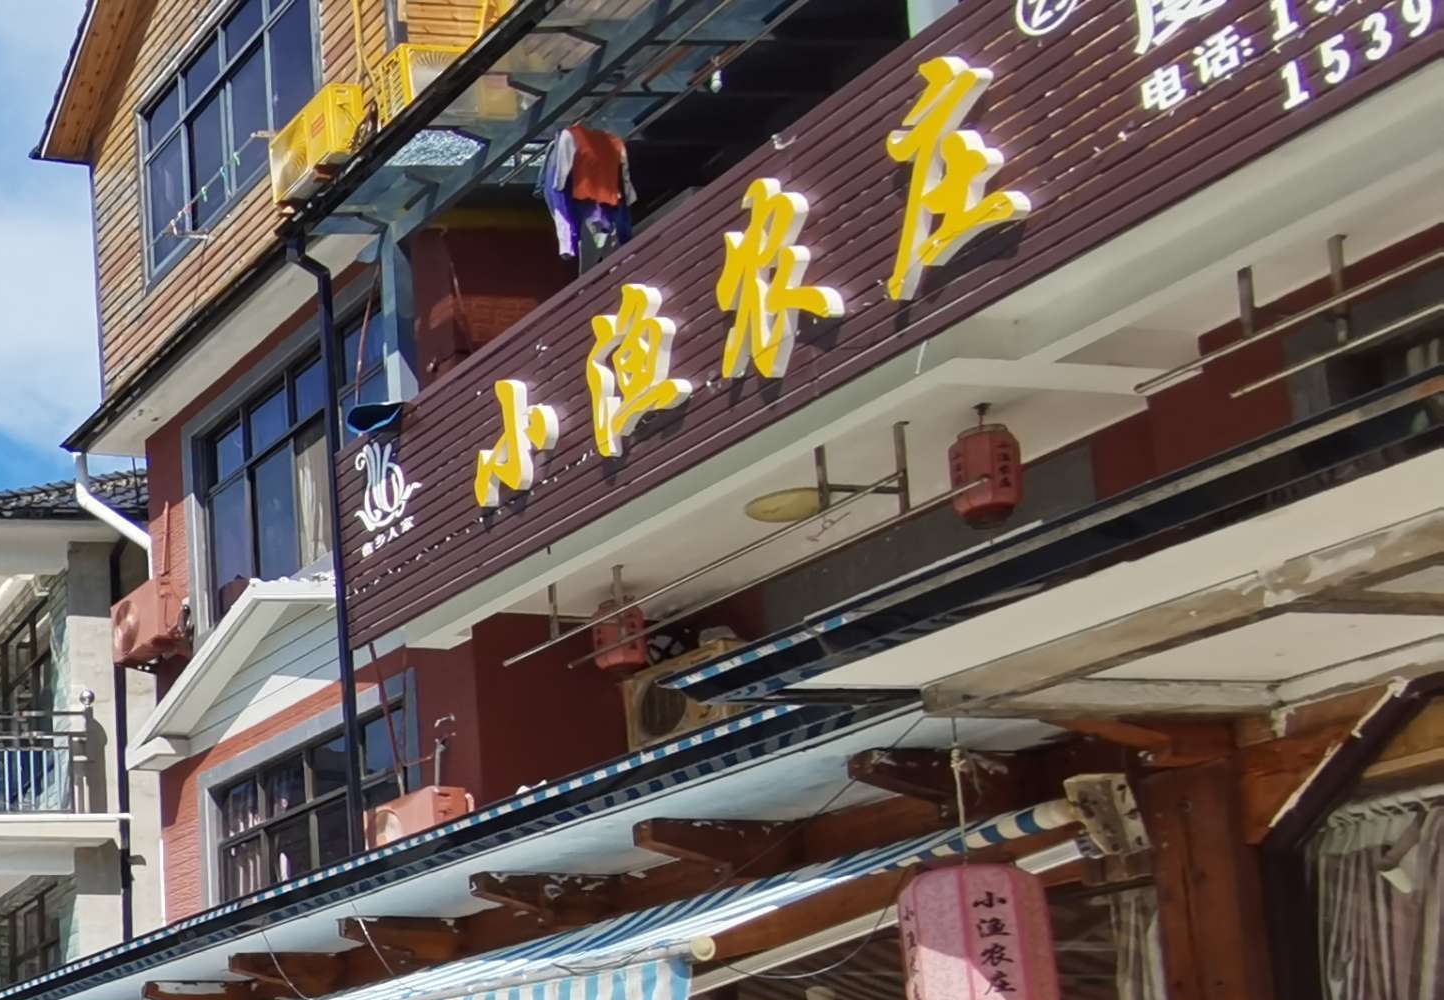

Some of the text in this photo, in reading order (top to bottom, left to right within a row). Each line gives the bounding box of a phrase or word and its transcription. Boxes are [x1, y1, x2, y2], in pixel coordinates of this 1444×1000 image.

[474, 56, 1031, 507] 小渔农庄
[972, 891, 1016, 996] 小渔农庄
